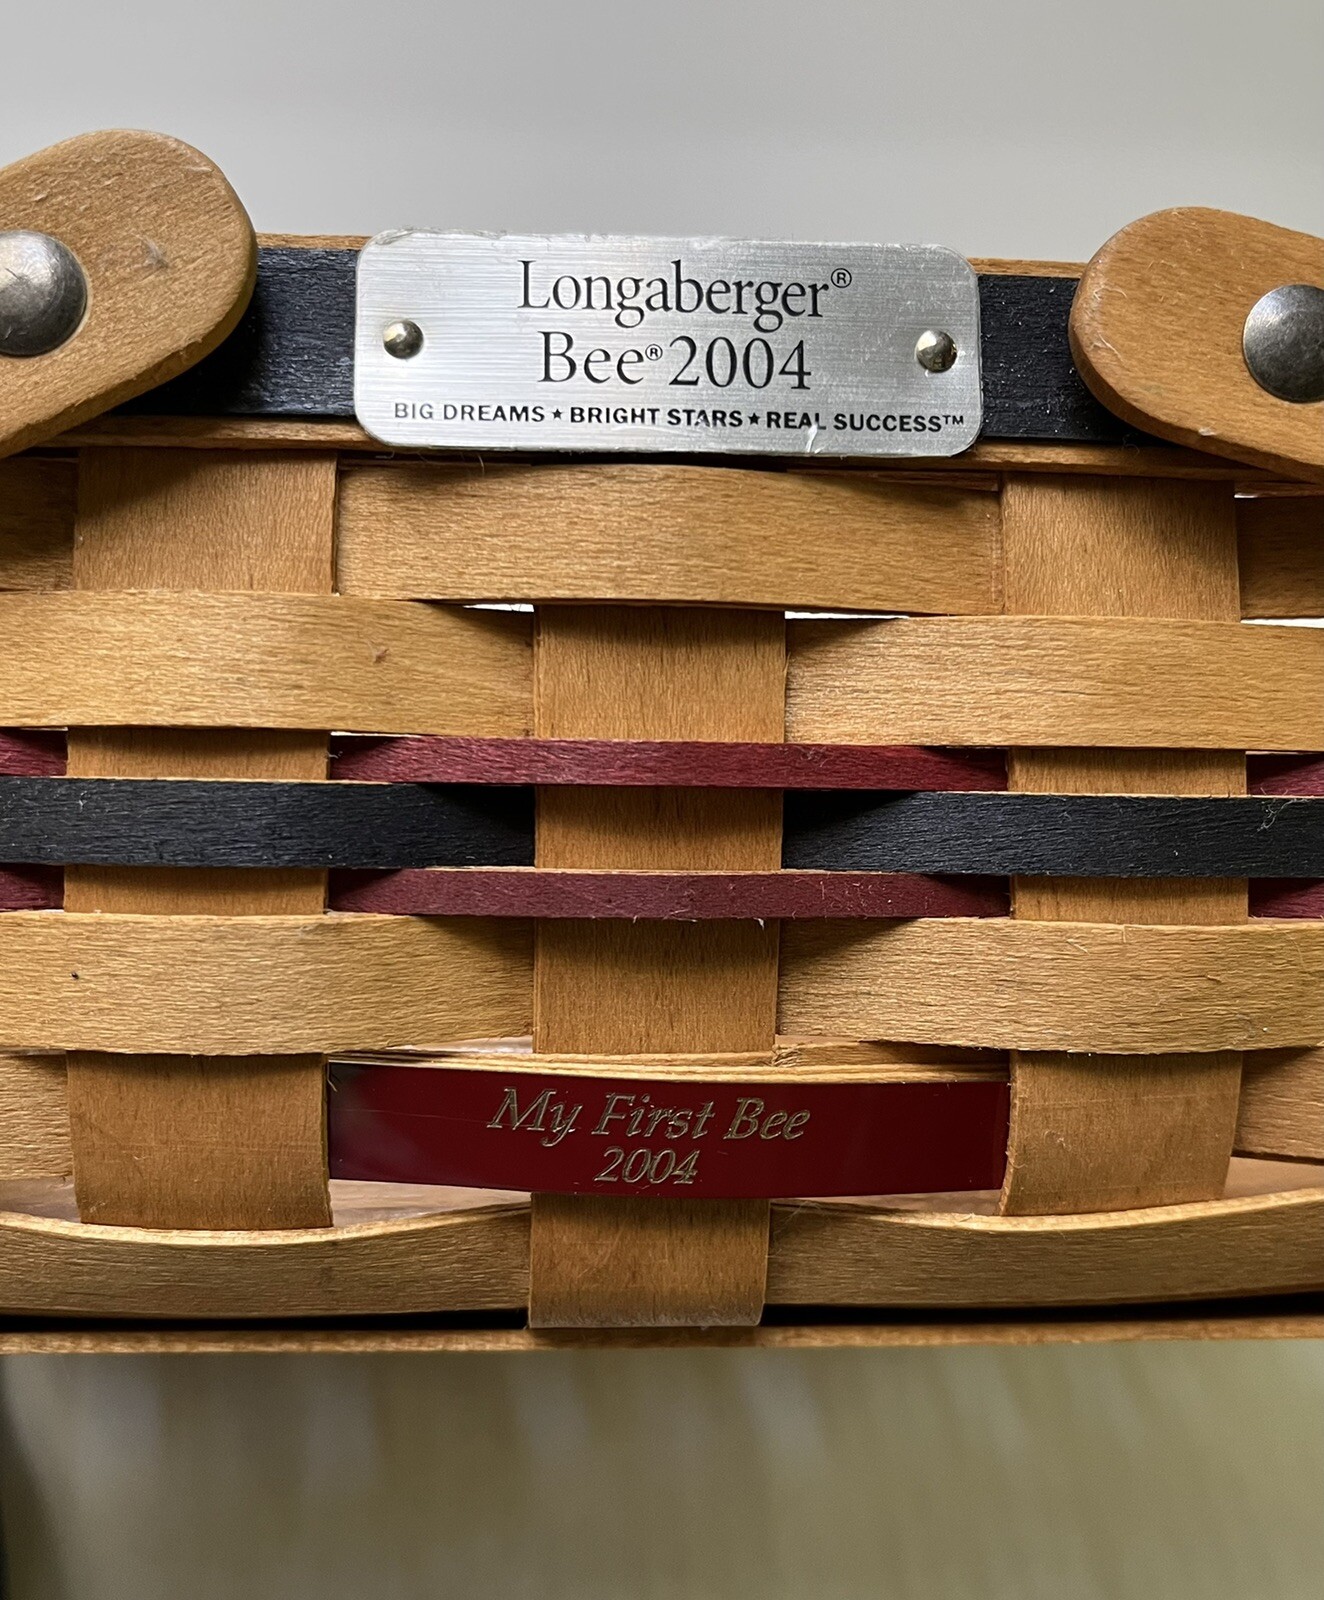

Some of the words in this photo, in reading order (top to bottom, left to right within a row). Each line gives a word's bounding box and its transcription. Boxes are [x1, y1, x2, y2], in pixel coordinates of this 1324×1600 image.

[668, 335, 813, 391] 2004
[394, 402, 434, 420] BIG
[443, 404, 546, 423] DREAMS
[570, 406, 661, 425] BRIGHT
[667, 408, 743, 428] STARS
[766, 411, 827, 430] REAL
[486, 1086, 583, 1147] My
[591, 1092, 716, 1140] First
[723, 1096, 811, 1141] Bee
[593, 1146, 701, 1186] 2004
